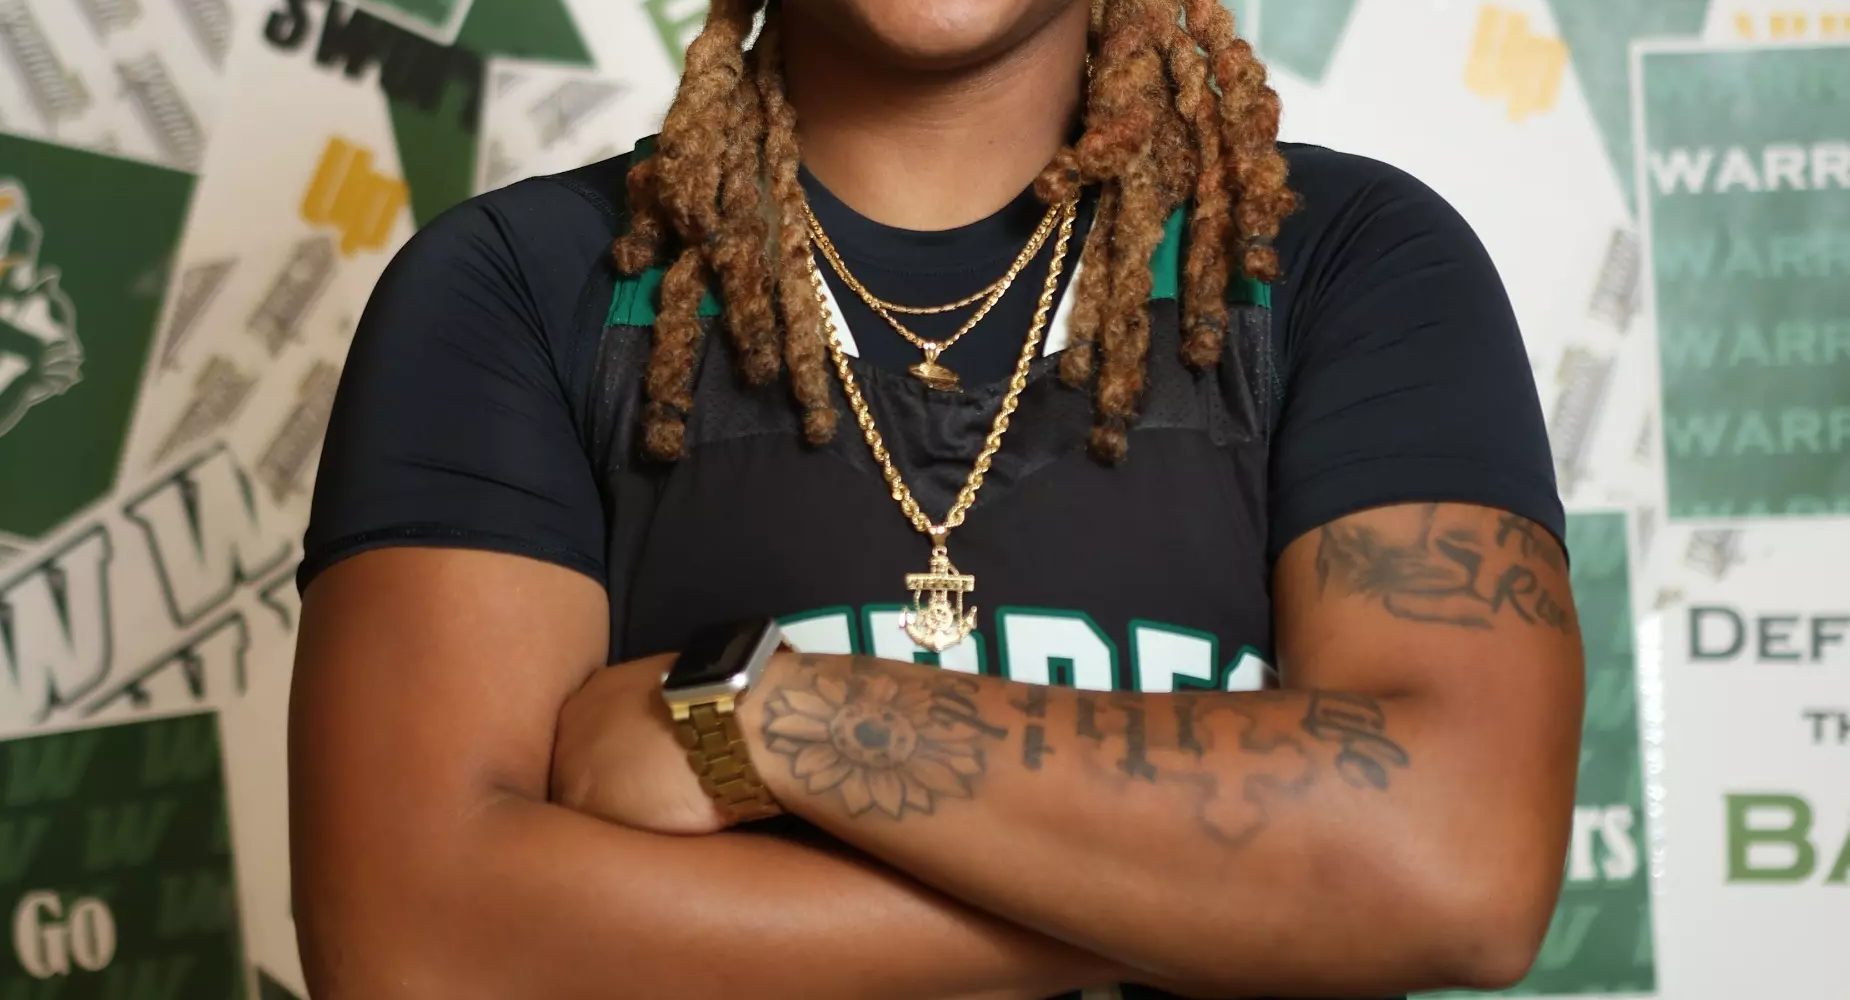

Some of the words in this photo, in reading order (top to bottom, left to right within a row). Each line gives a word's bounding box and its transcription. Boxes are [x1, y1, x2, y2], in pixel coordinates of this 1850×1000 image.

[1648, 142, 1850, 194] WARR
[1687, 606, 1850, 664] DEF
[13, 892, 117, 979] Go
